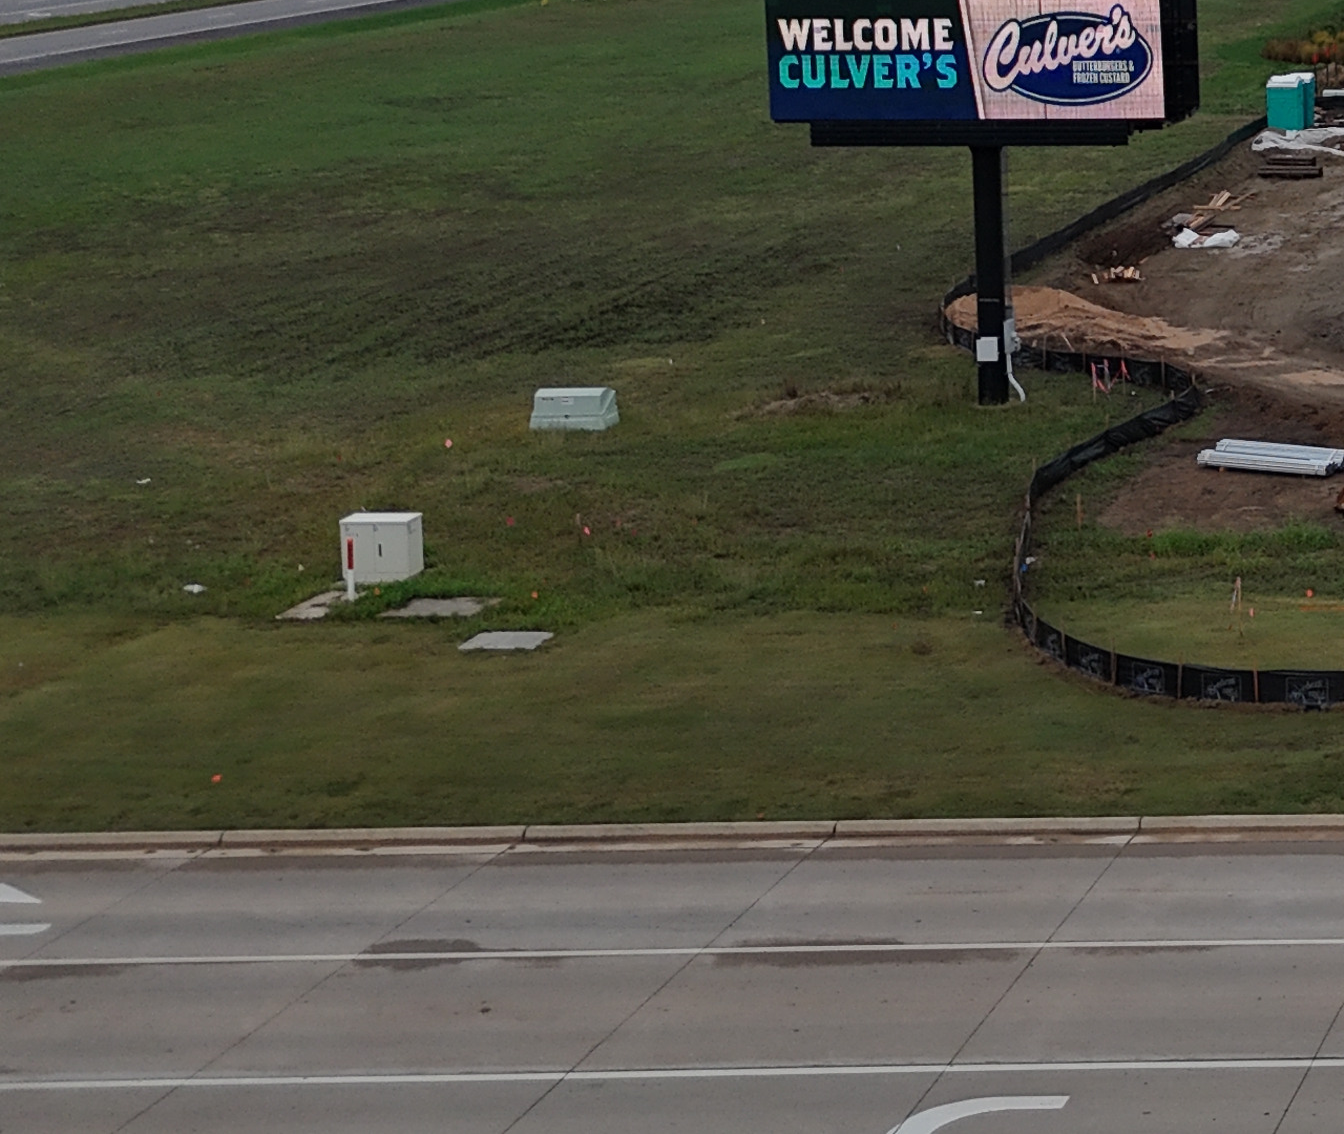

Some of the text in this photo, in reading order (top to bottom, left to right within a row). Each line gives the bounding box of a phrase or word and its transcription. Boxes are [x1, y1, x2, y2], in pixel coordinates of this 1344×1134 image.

[777, 18, 954, 51] WELCOME
[984, 5, 1136, 90] Culver's
[779, 52, 958, 89] CULVER'S
[1073, 72, 1130, 84] FROZEN CUSTARD
